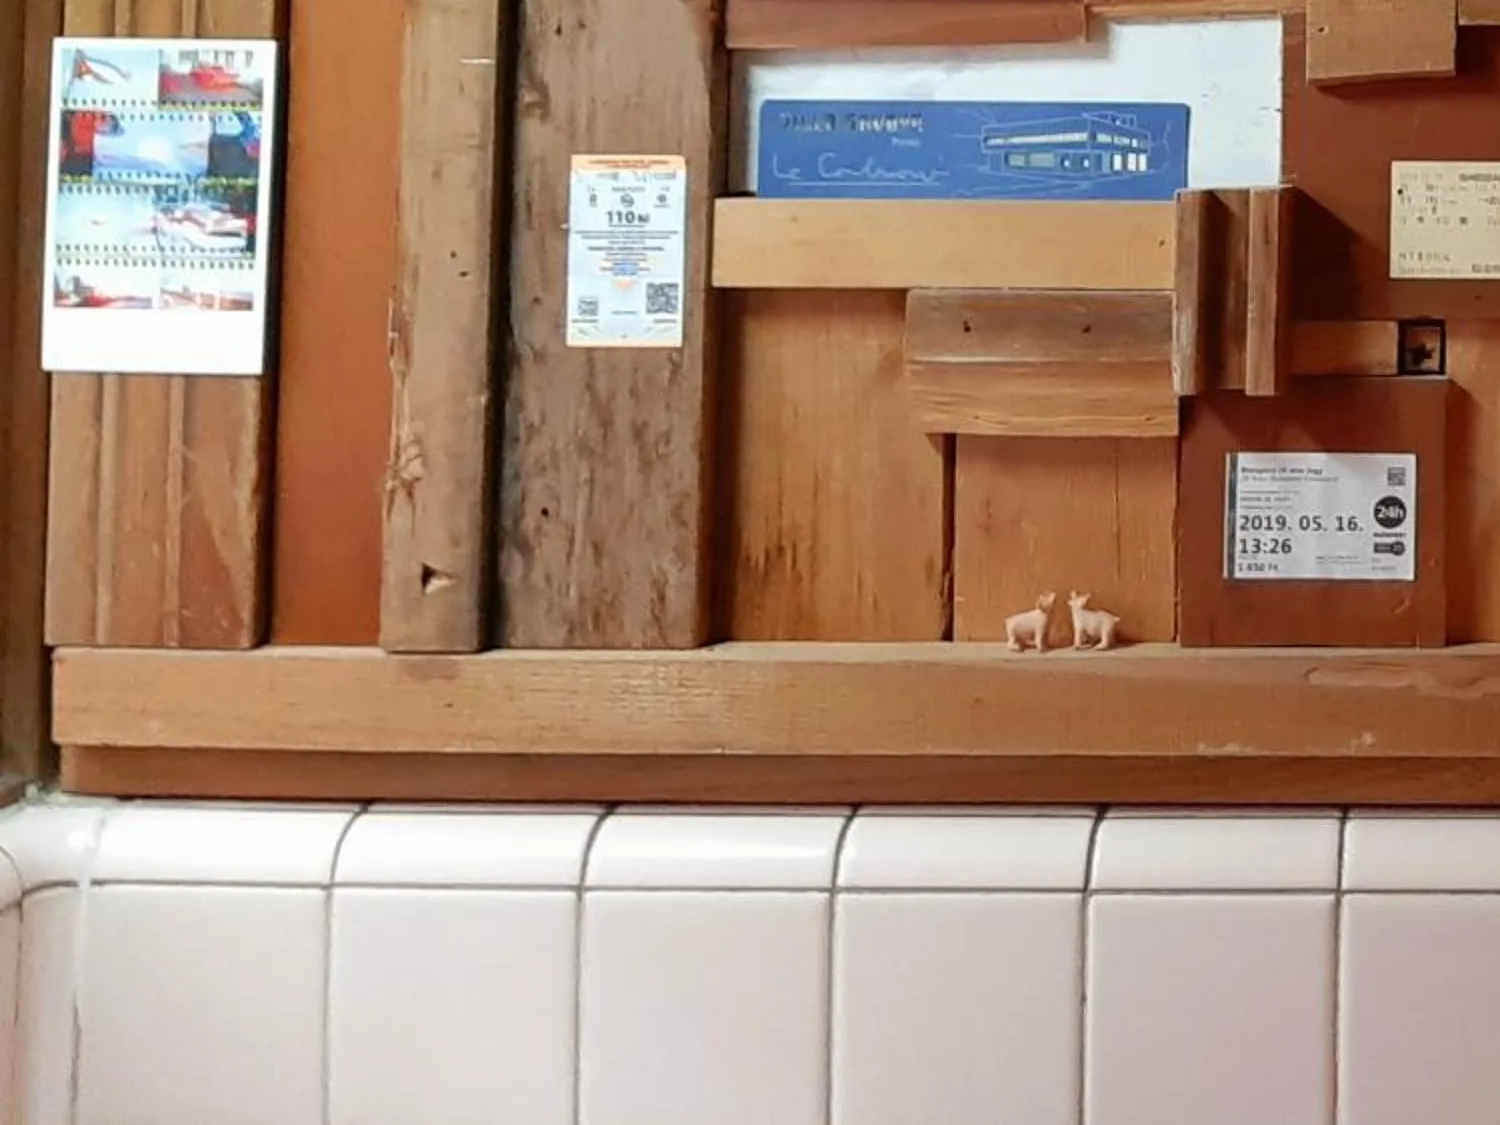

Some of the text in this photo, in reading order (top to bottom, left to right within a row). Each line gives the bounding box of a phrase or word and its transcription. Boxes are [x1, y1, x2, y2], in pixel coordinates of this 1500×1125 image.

[606, 211, 636, 224] 110
[1238, 514, 1364, 532] 2019. 05. 16.
[1238, 537, 1293, 555] 13:26
